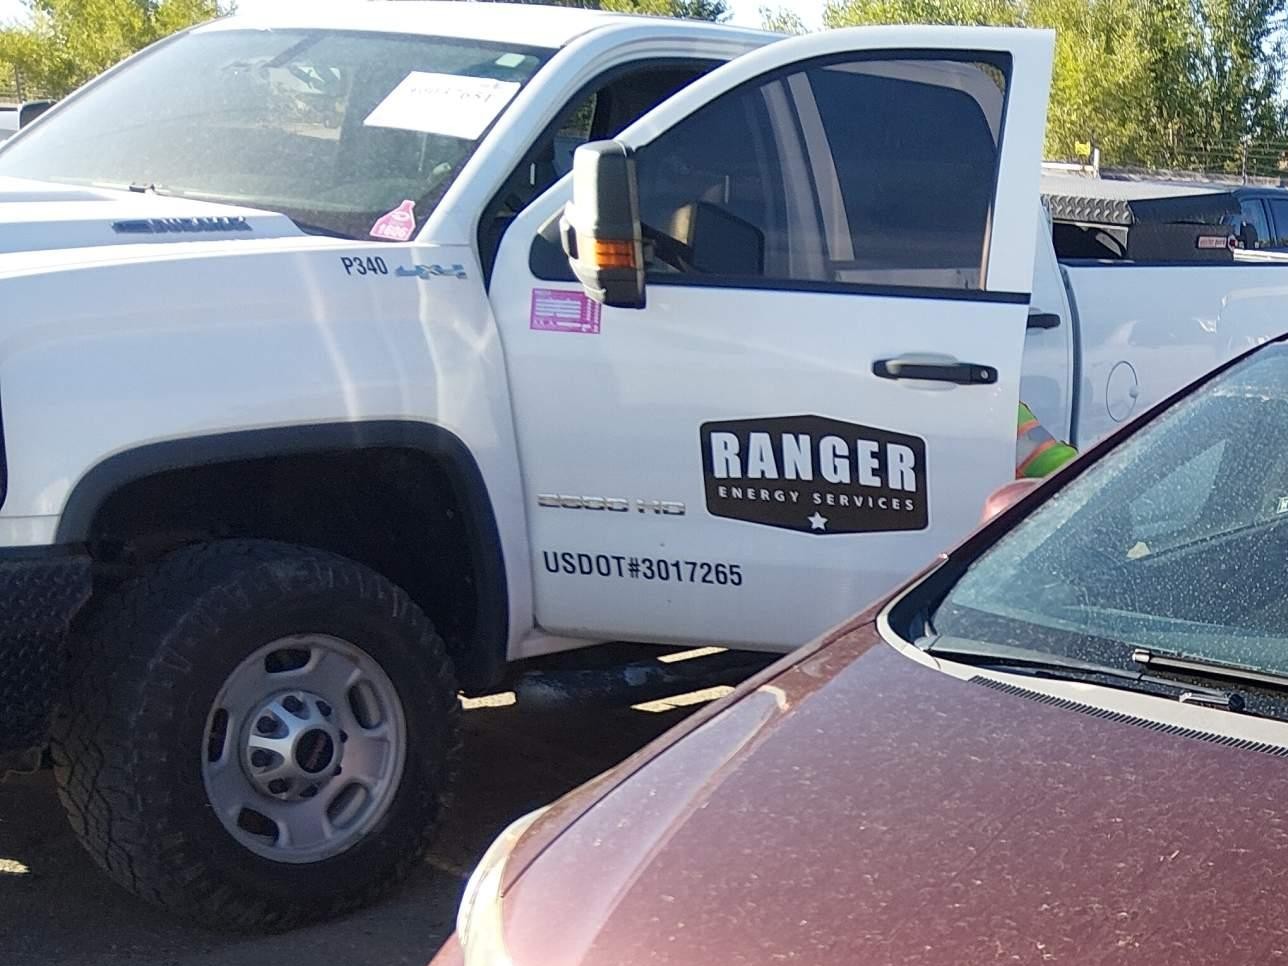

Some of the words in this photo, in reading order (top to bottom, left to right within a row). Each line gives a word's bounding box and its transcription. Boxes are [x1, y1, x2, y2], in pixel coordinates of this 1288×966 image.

[341, 256, 389, 276] P340
[710, 431, 917, 492] RANGER
[718, 485, 799, 503] ENERGY
[813, 491, 914, 512] SERVICES
[543, 551, 744, 586] USDOT#3017265
